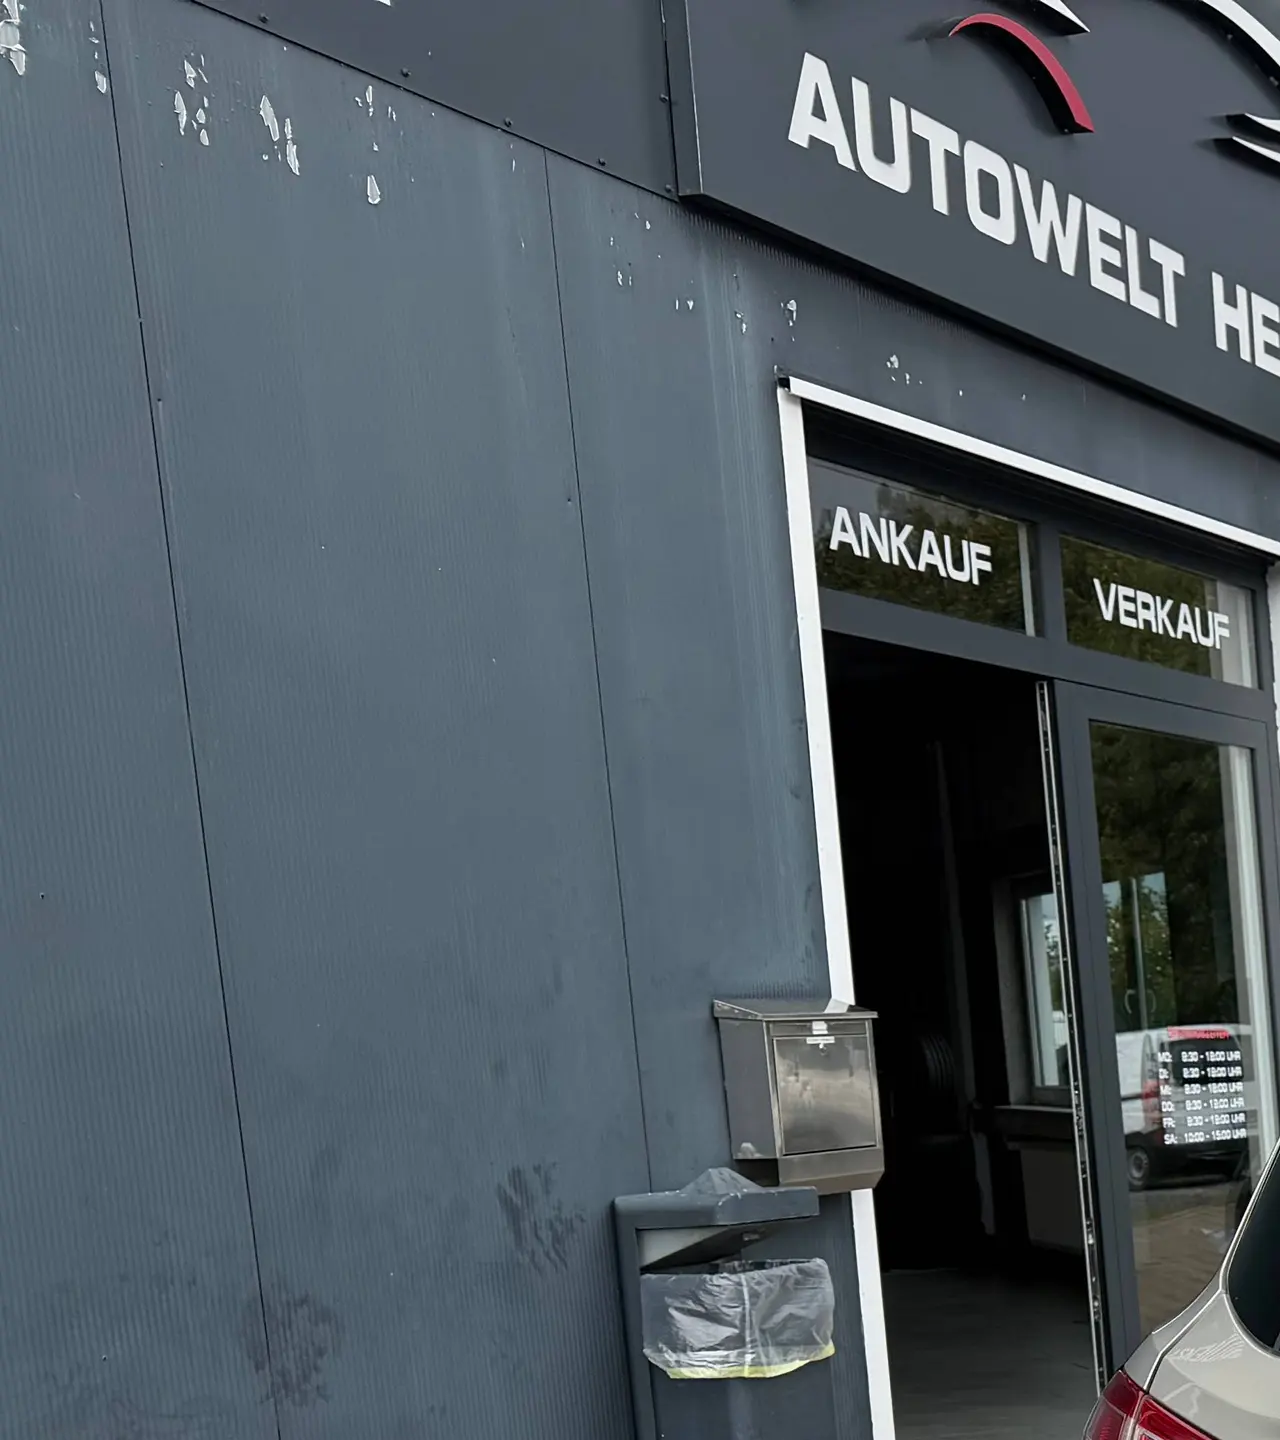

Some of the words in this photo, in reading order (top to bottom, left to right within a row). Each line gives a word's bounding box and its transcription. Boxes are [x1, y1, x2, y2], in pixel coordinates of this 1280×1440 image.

[788, 52, 1185, 327] AUTOWELT
[829, 506, 992, 585] ANKAUF
[1093, 578, 1230, 650] VERKAUF
[1226, 1051, 1241, 1061] UHR
[1227, 1066, 1242, 1077] UHR
[1229, 1082, 1244, 1093] UHR
[1230, 1097, 1245, 1108] UHR
[1231, 1113, 1246, 1123] UHR
[1232, 1128, 1247, 1139] UHR
